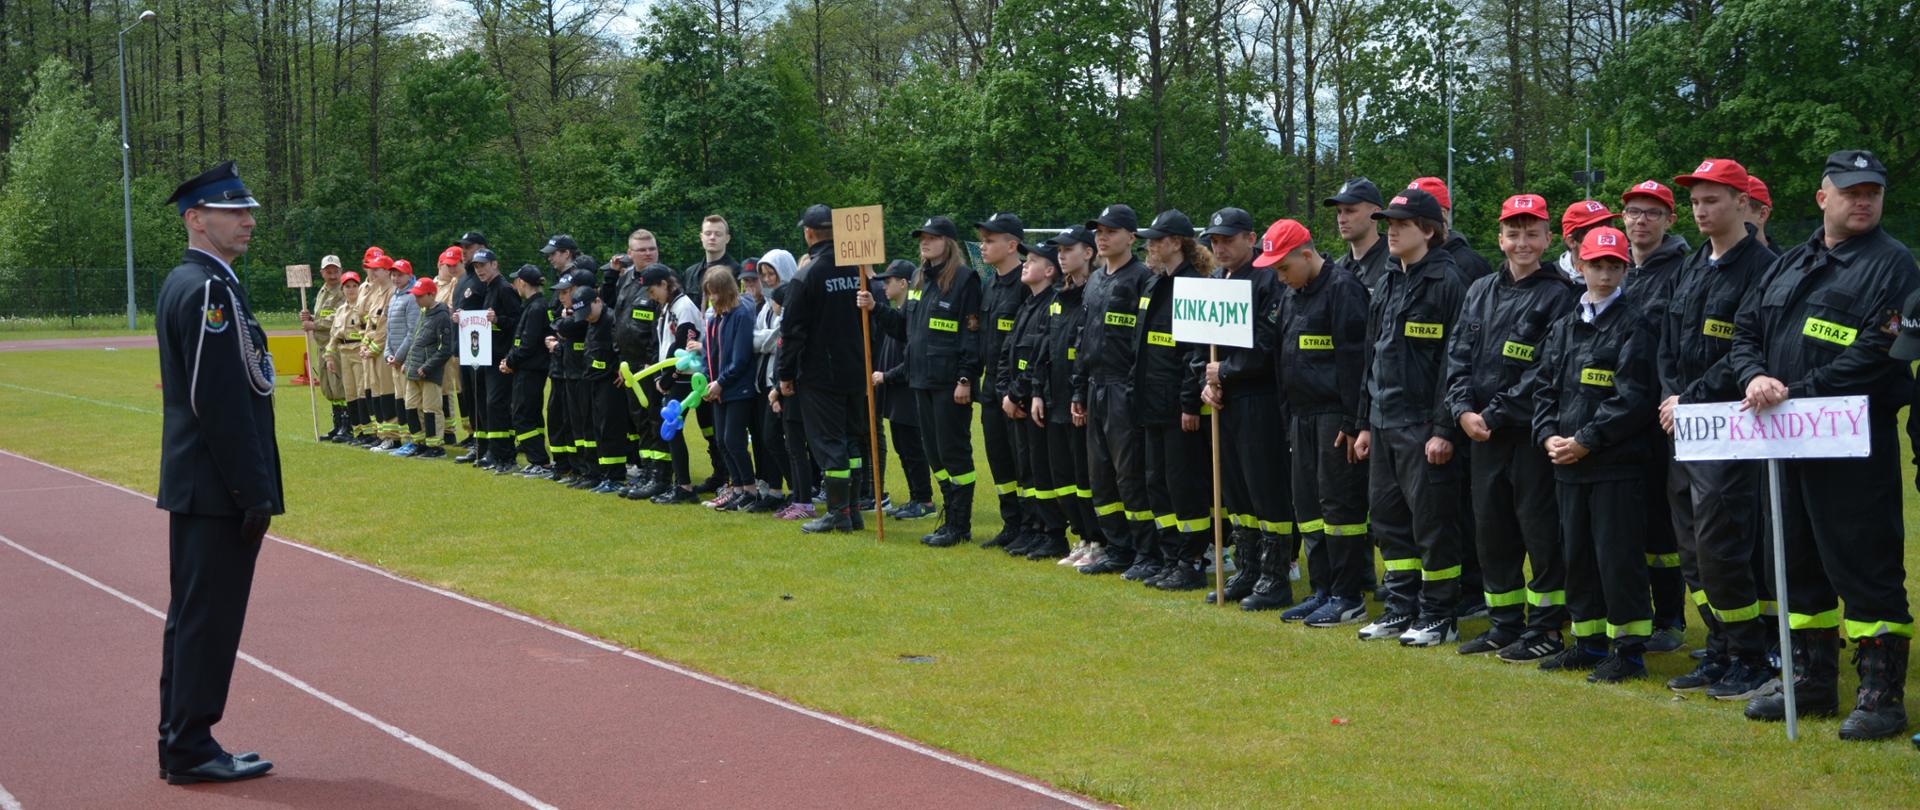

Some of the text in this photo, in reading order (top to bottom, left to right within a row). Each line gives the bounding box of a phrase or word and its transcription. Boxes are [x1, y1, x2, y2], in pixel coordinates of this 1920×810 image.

[845, 213, 870, 232] OSP
[840, 240, 877, 259] GALINY
[1174, 298, 1249, 327] KINKAJMY
[933, 320, 954, 330] STRAZ
[1107, 314, 1135, 326] STRAZ
[1409, 325, 1438, 335] STRAZ
[1710, 323, 1734, 336] STR
[1810, 323, 1850, 342] STRAZ
[1303, 338, 1331, 347] STRAZ
[1507, 344, 1534, 359] STRA
[1586, 372, 1614, 383] STRA
